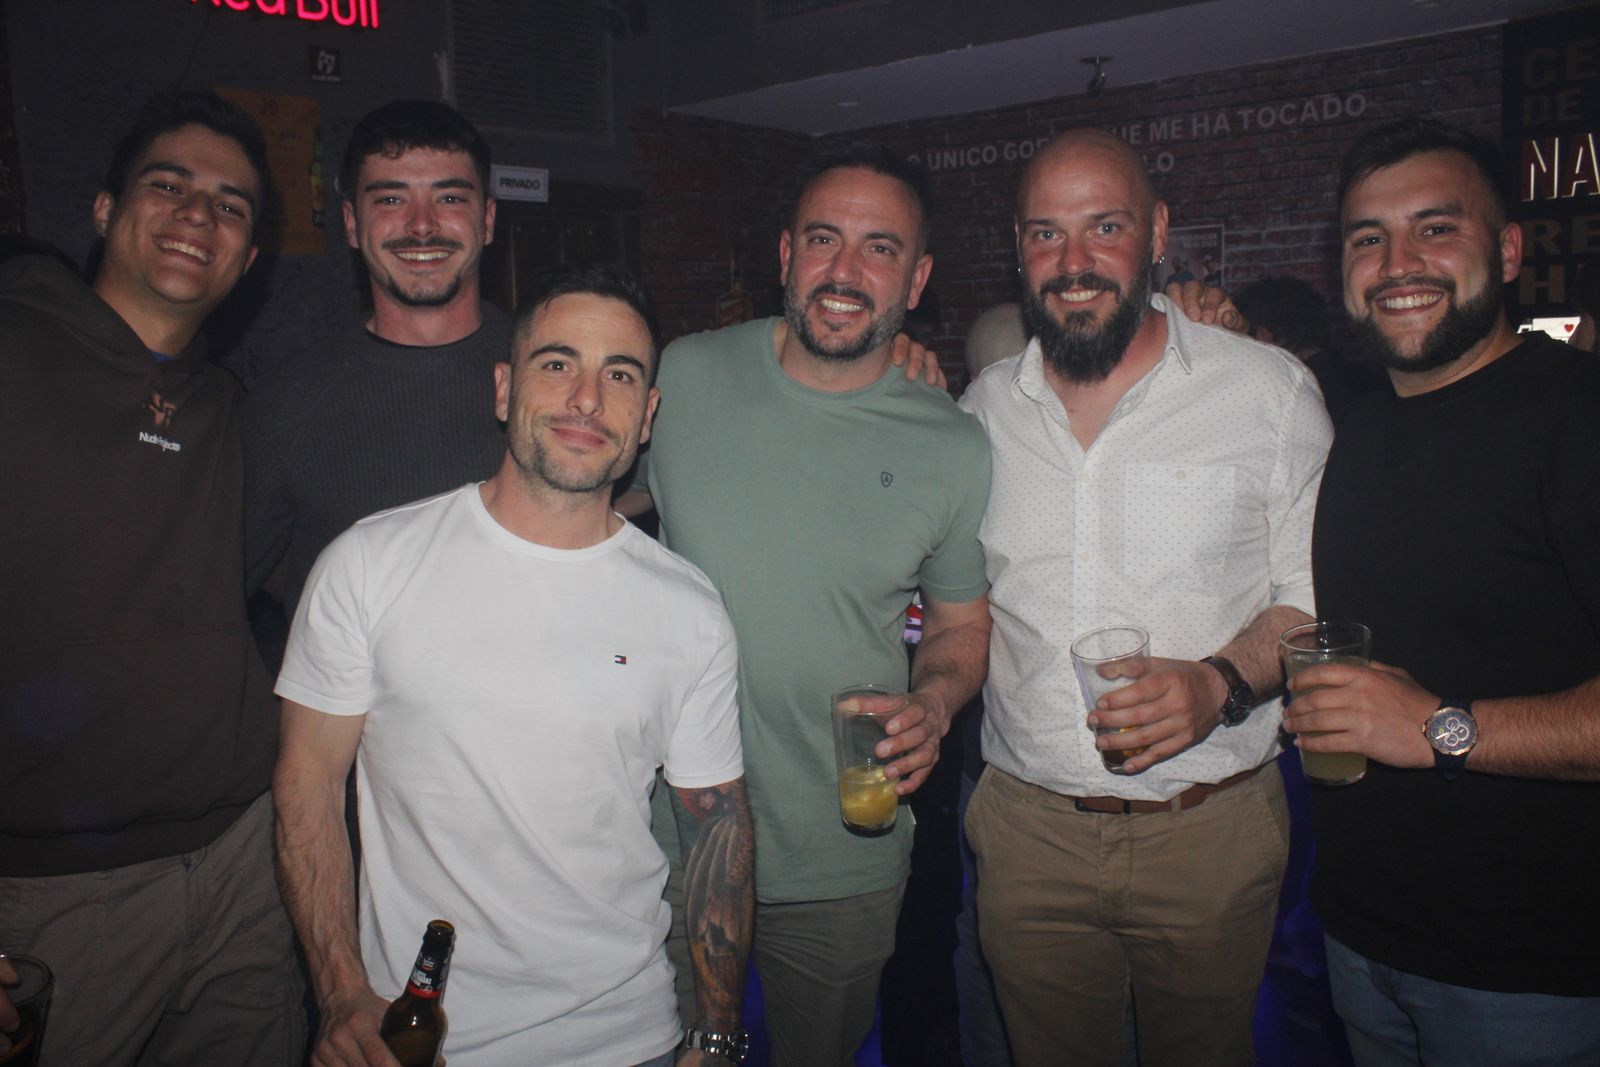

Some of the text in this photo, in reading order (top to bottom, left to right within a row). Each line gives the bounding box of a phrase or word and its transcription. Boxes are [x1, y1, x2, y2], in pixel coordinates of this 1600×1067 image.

[1149, 118, 1184, 143] ME
[1192, 113, 1231, 138] HA
[1237, 93, 1367, 131] TOCADO
[500, 176, 540, 190] PRIVADO
